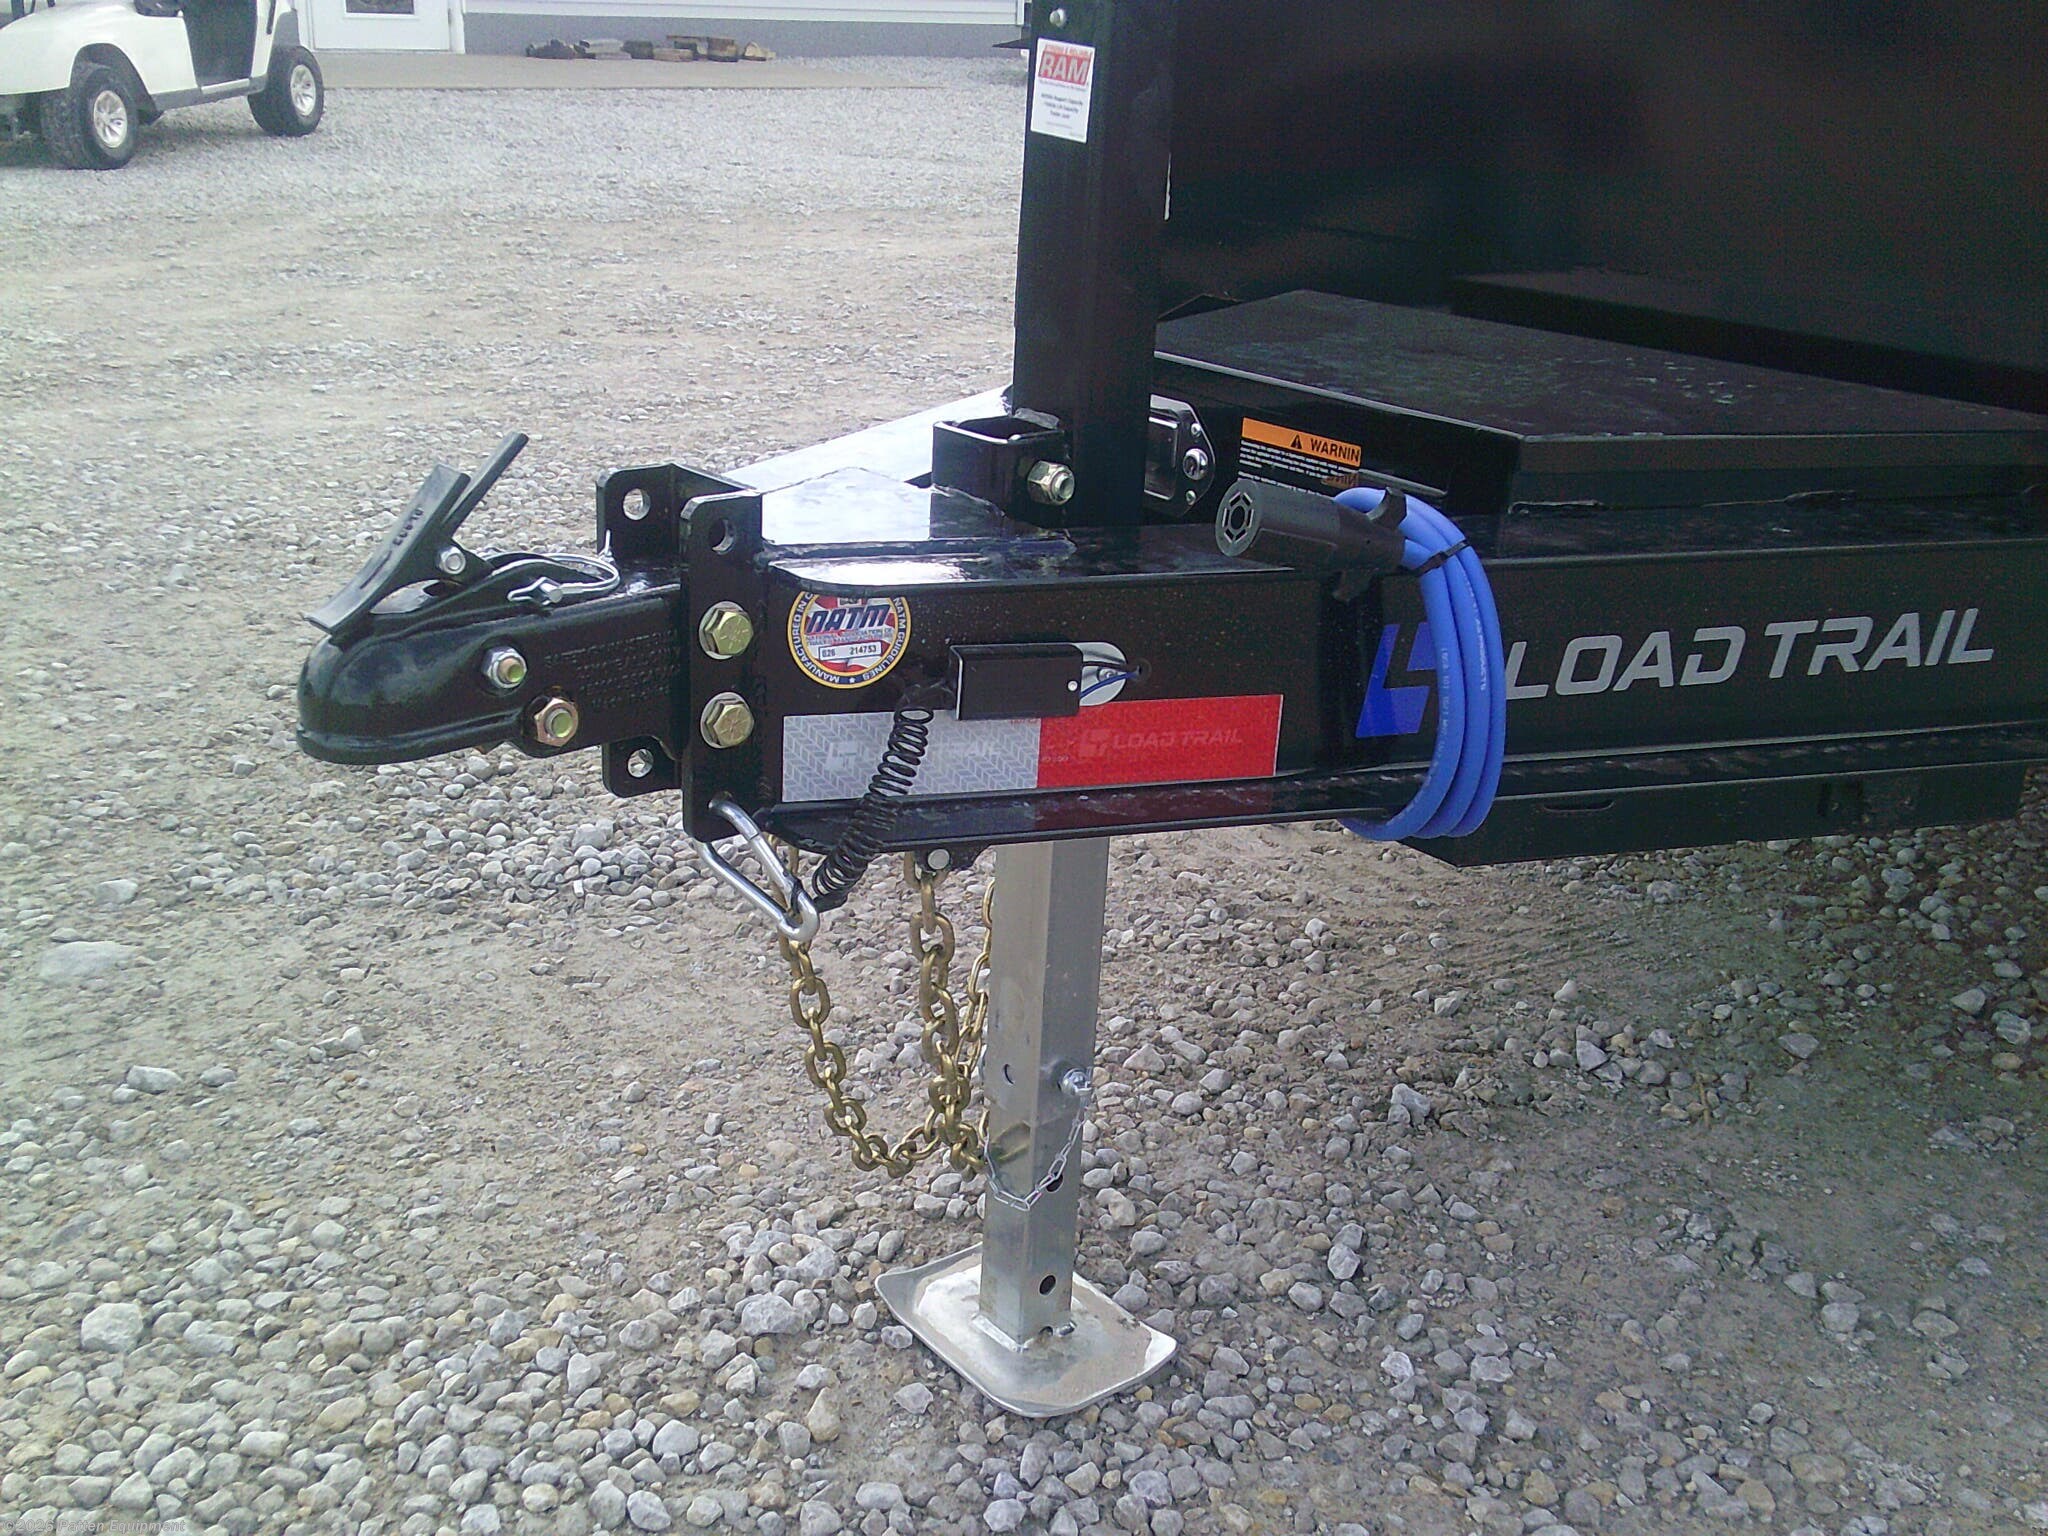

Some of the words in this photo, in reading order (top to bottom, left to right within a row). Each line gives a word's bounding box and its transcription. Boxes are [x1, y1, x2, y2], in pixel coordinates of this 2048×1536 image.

[1040, 53, 1089, 85] RAM
[1310, 437, 1360, 463] WARNIN
[797, 600, 808, 614] IN
[806, 604, 892, 634] NATM
[893, 598, 906, 630] NATM
[791, 614, 840, 684] MANUFACTURED
[862, 631, 906, 682] GUIDELINES
[1506, 625, 1745, 700] LOAD
[1763, 607, 1995, 680] TRAIL
[1113, 730, 1176, 750] LOAD
[1182, 728, 1244, 747] TRAIL
